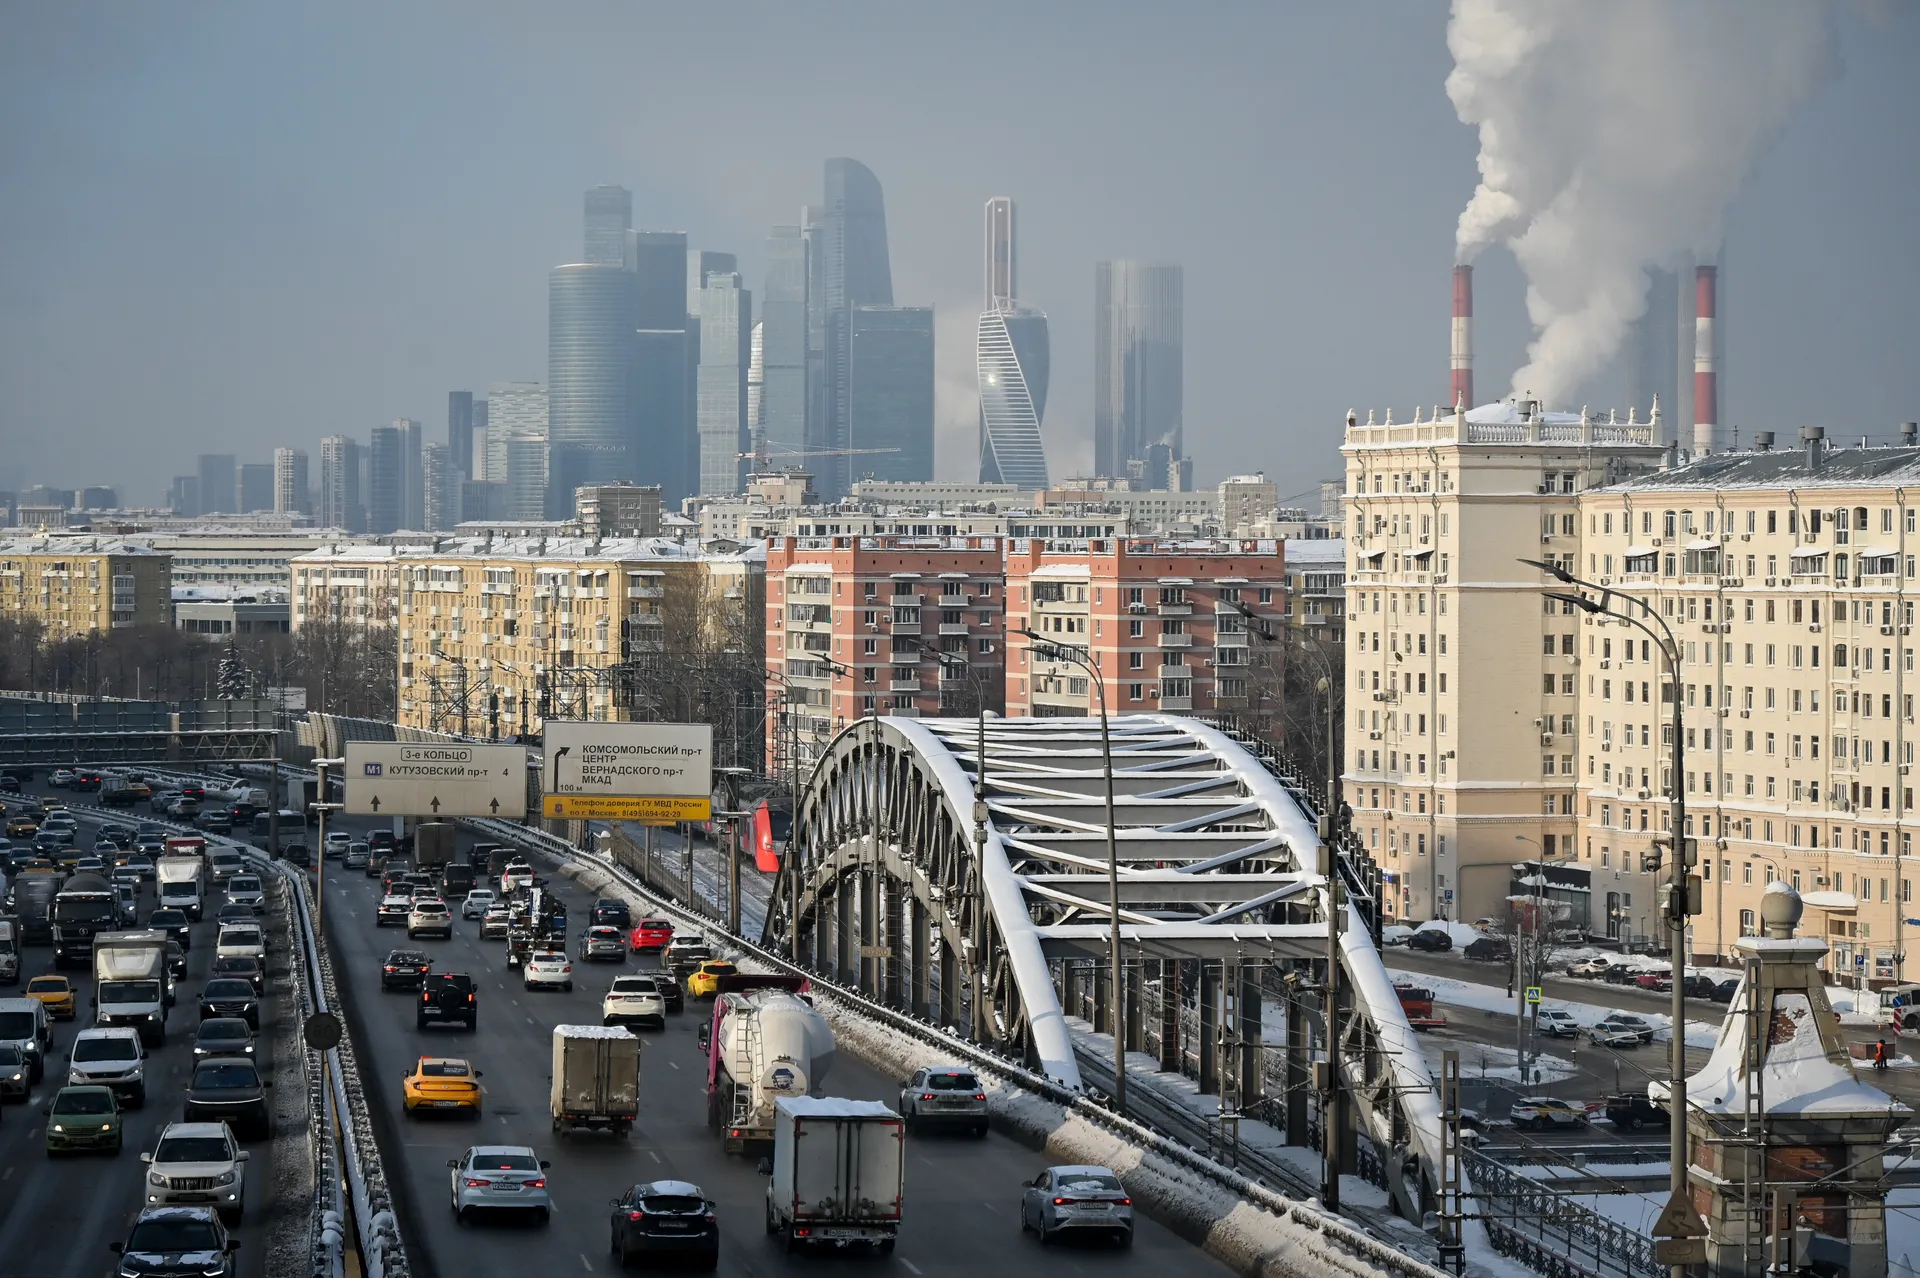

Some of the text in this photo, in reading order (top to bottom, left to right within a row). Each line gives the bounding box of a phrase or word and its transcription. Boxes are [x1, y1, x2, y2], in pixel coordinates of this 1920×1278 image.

[405, 750, 468, 761] 3-е КОЛЬЦО
[582, 745, 702, 756] КОМСОМОЛЬСКИЙ пр-т
[582, 755, 617, 764] ЦЕНТР
[389, 765, 465, 776] КУТУЗОВСКИЙ
[467, 769, 488, 778] пр-т
[502, 769, 509, 777] 4
[582, 766, 684, 777] ВЕРНАДСКОГО пр-т
[582, 776, 612, 786] МКАД
[570, 799, 604, 808] Телефон
[642, 800, 652, 808] ГУ
[653, 800, 672, 808] МВД
[674, 800, 702, 808] России
